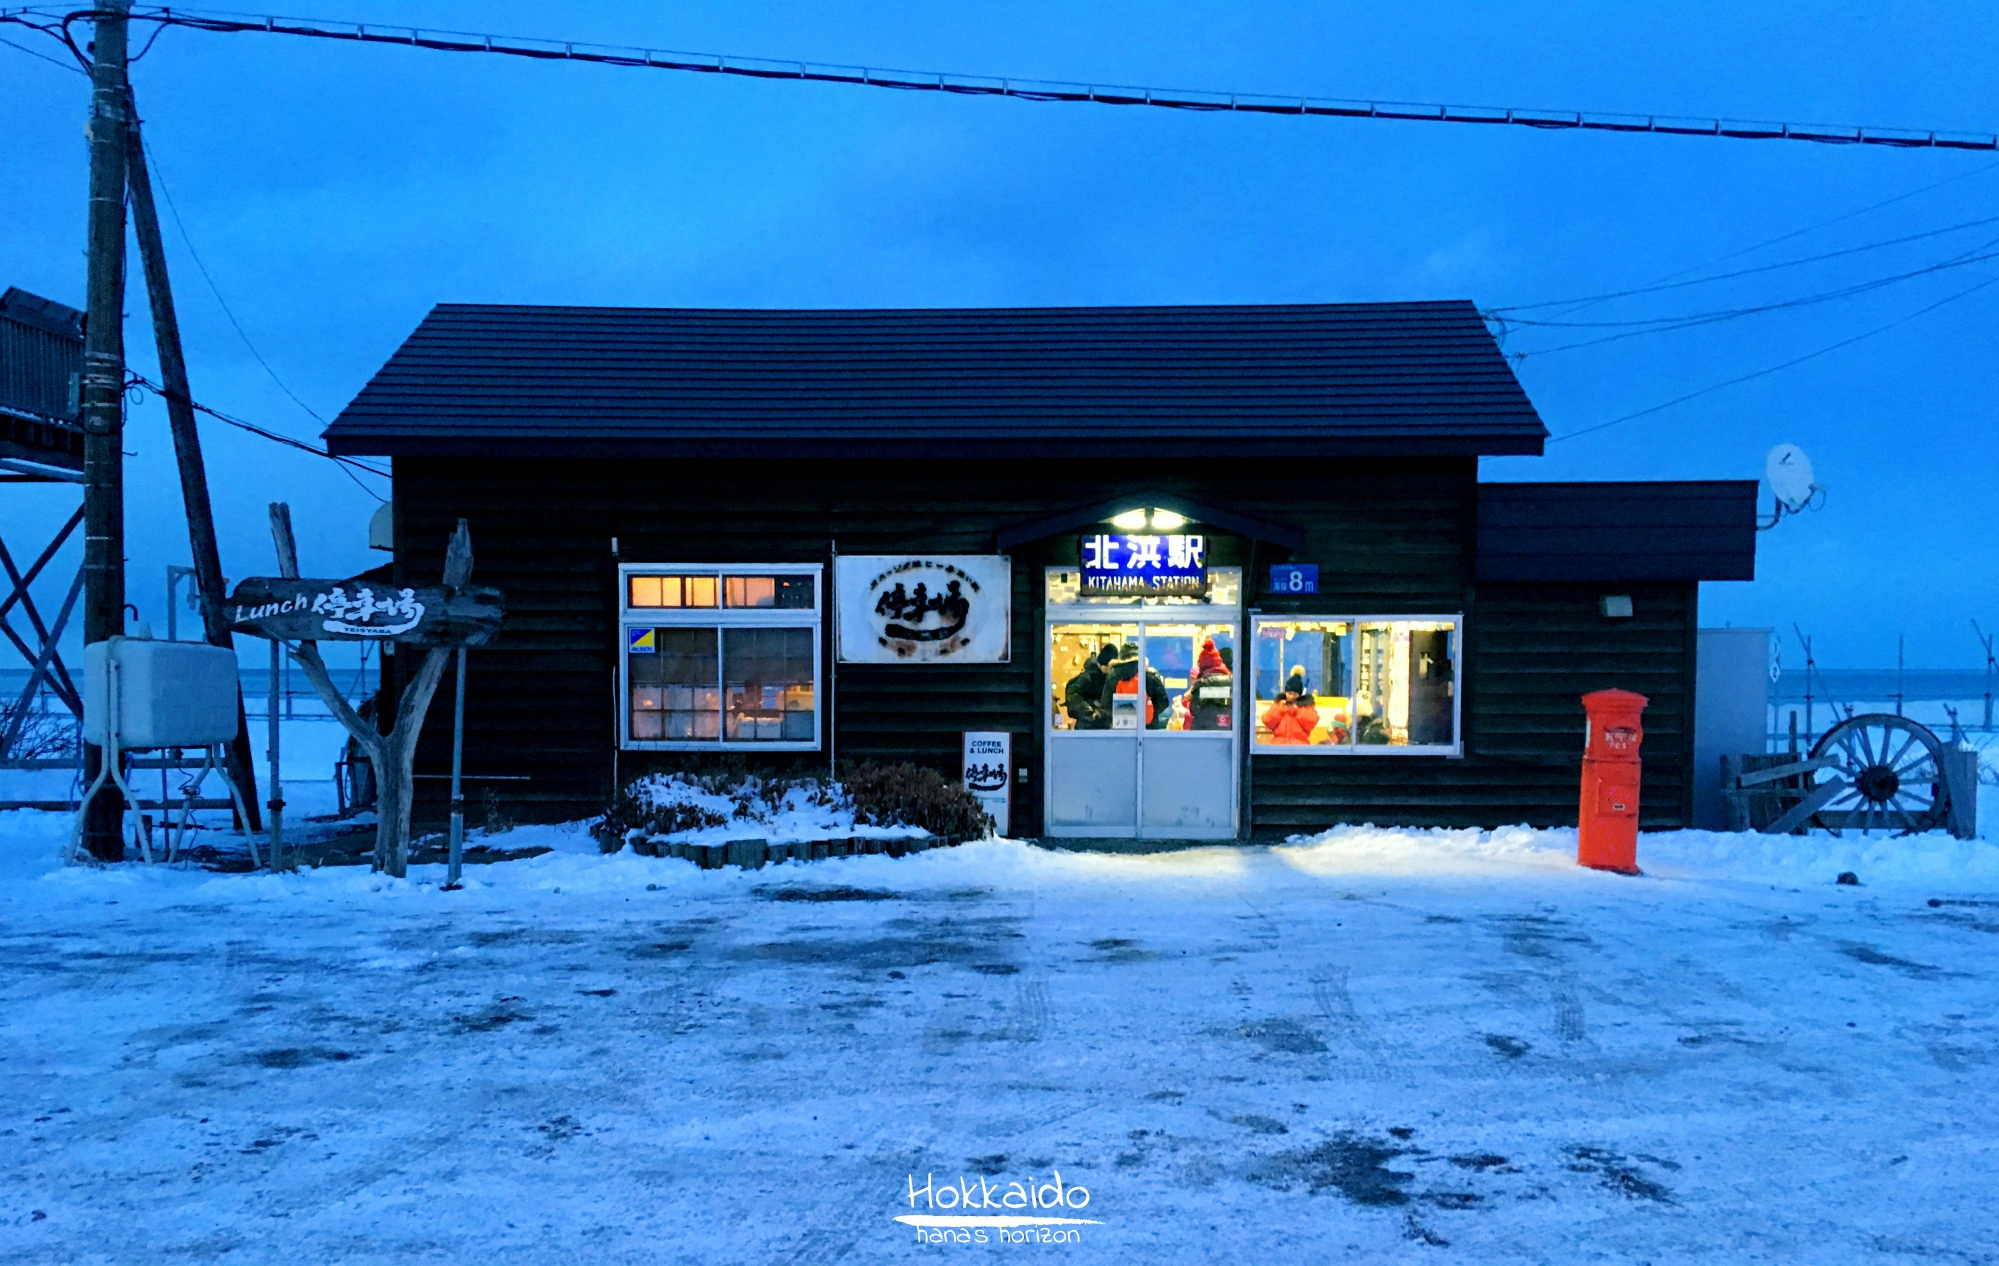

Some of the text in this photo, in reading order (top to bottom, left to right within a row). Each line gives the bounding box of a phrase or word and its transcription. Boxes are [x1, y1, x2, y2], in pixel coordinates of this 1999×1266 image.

[1085, 535, 1203, 569] 北浜駅
[1088, 576, 1200, 591] KITAHAMA STATION
[1289, 571, 1303, 592] 8
[1305, 581, 1314, 592] m
[234, 587, 425, 634] Lunch 停車場
